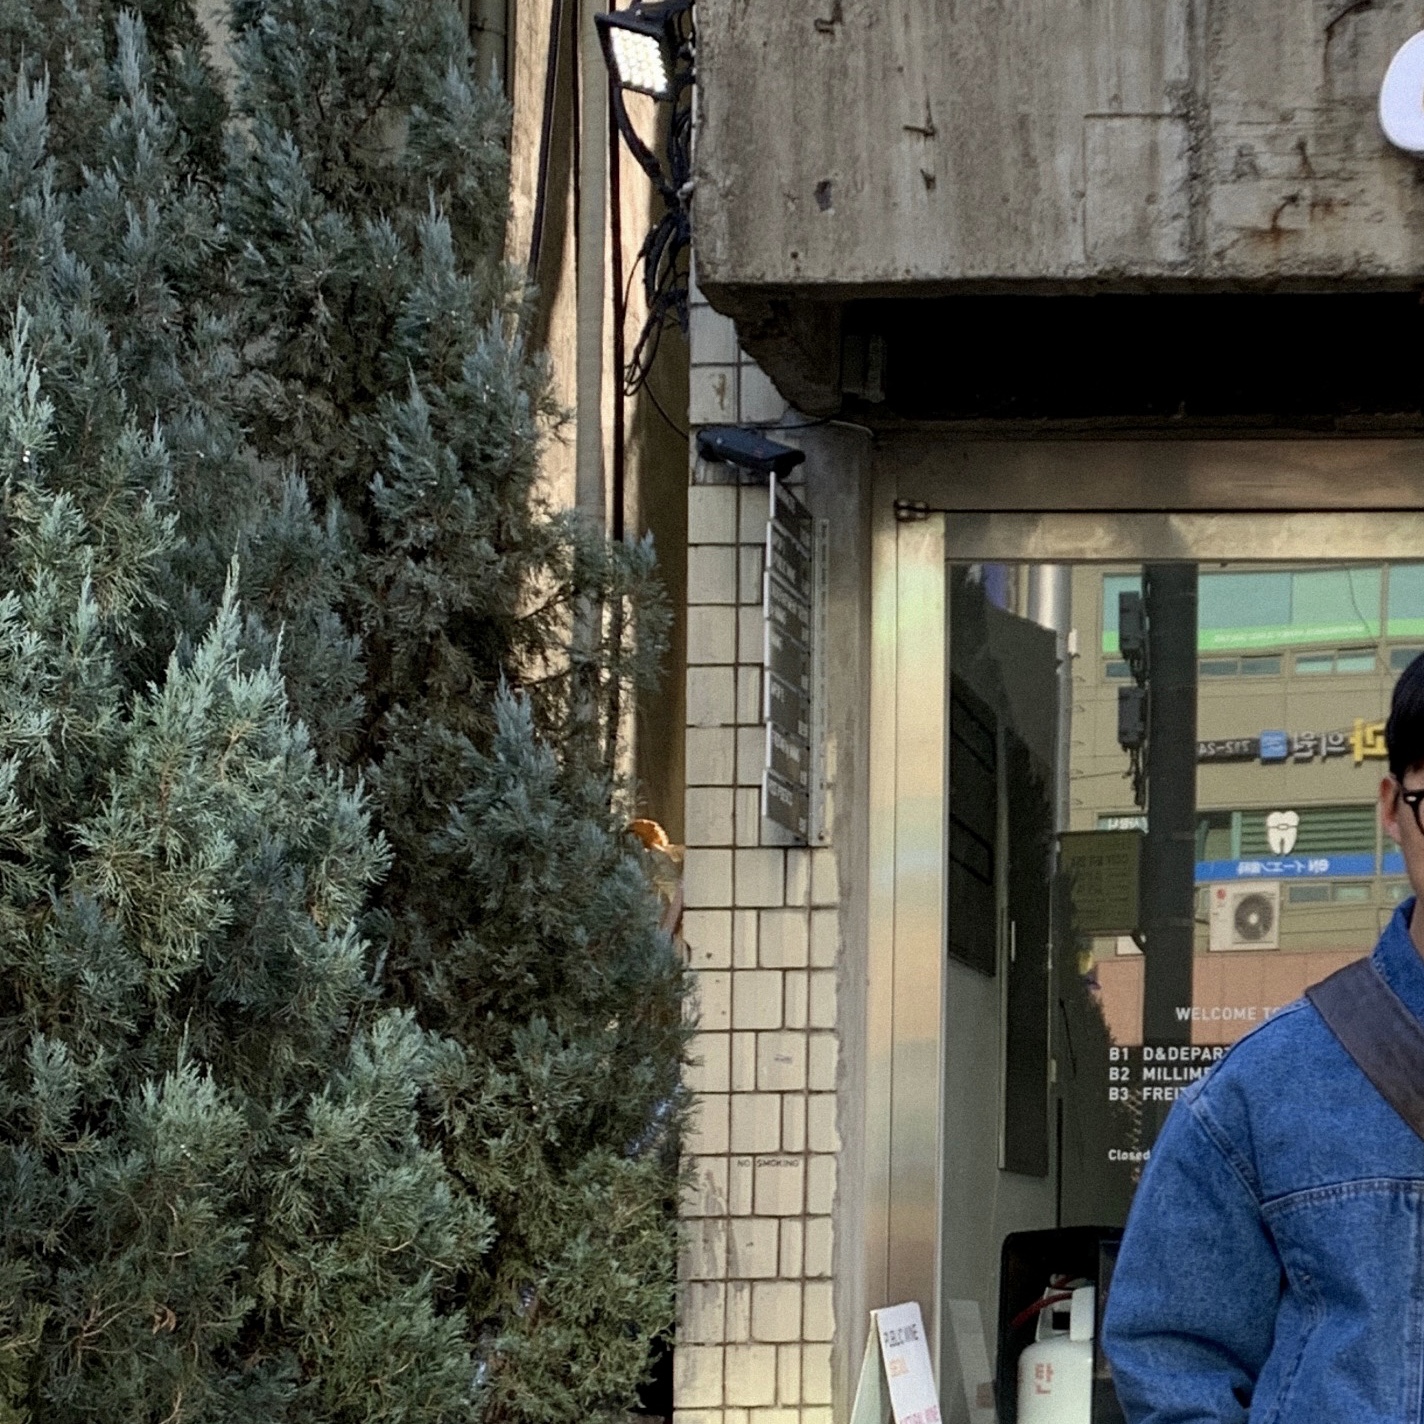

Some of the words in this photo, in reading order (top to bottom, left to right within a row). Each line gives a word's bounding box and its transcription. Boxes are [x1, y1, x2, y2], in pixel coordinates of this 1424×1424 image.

[1175, 1006, 1257, 1021] WELCOME
[1108, 1046, 1129, 1061] B1
[1108, 1066, 1130, 1081] B2
[1108, 1086, 1129, 1101] B3
[1108, 1148, 1151, 1161] Closed
